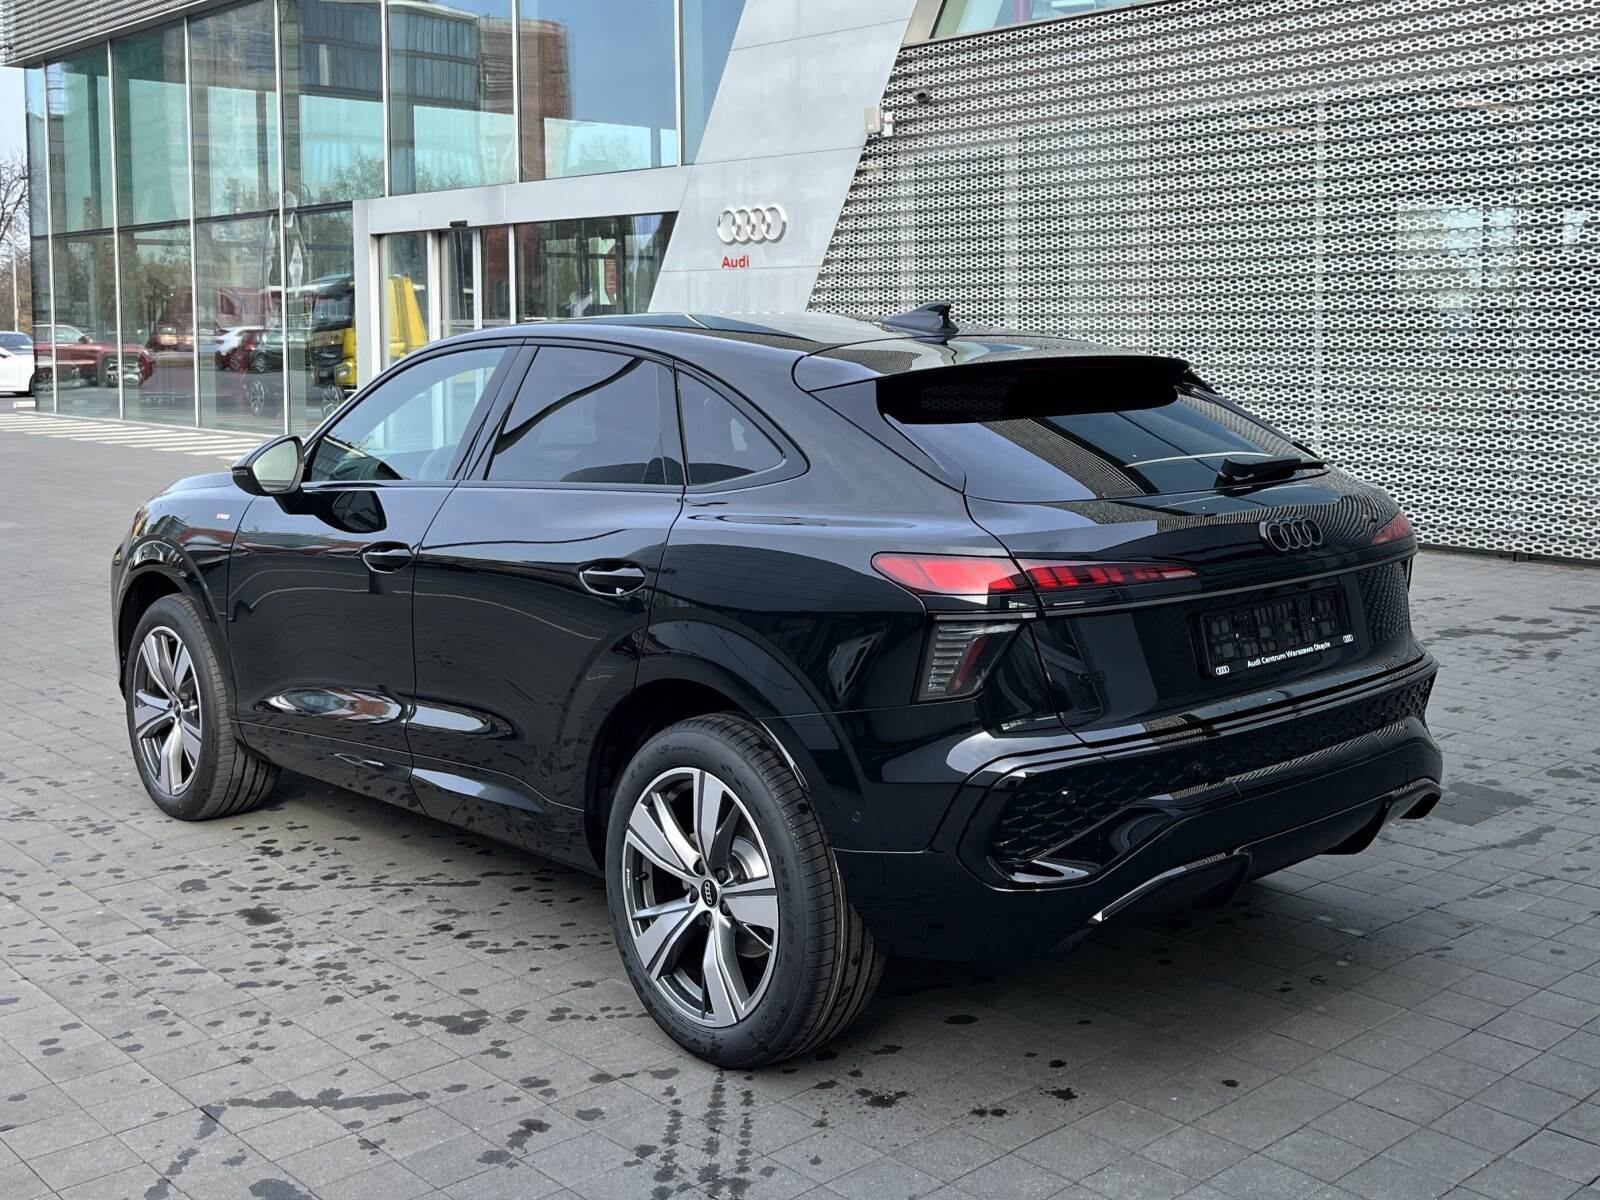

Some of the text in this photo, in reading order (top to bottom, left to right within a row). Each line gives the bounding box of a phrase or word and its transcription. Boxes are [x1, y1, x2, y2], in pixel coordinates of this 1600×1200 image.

[721, 255, 750, 268] Audi
[1247, 658, 1261, 668] Audi
[1261, 653, 1286, 664] Centrum
[1285, 646, 1314, 658] Warszawa
